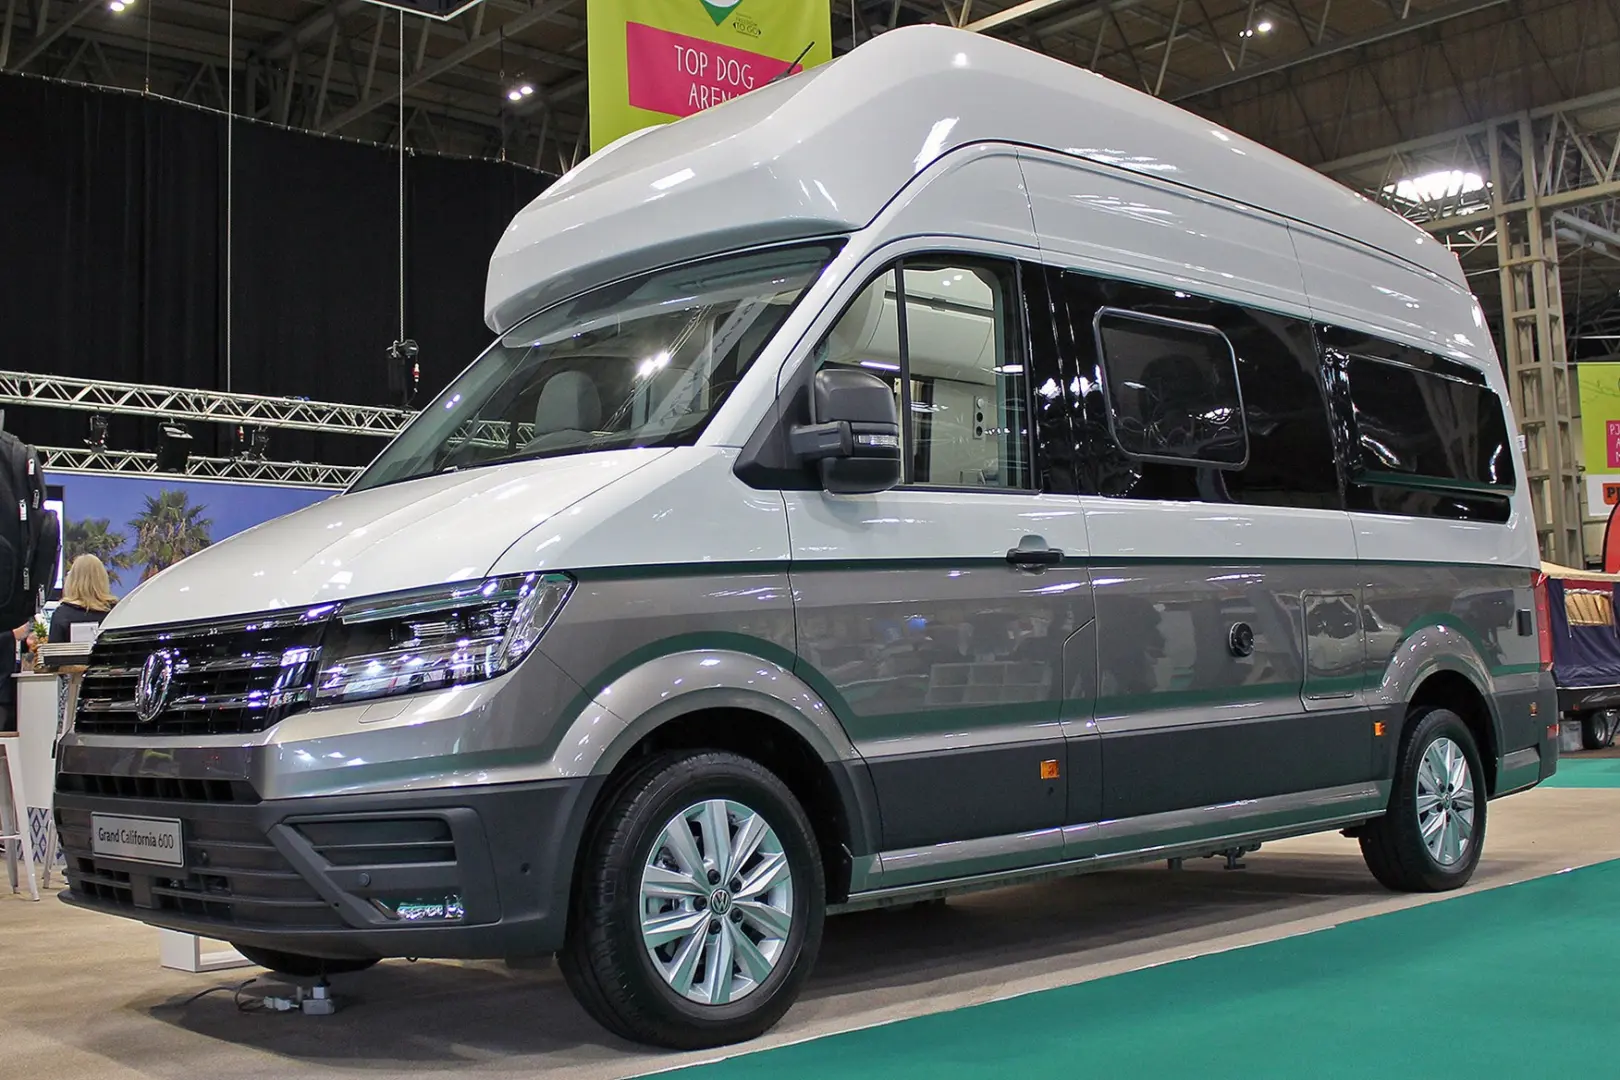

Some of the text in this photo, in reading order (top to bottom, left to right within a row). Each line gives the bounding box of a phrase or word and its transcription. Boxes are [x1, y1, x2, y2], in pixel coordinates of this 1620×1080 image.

[674, 44, 754, 90] TOP DOG
[688, 83, 740, 109] ARE
[98, 827, 174, 849] Grand California 600
